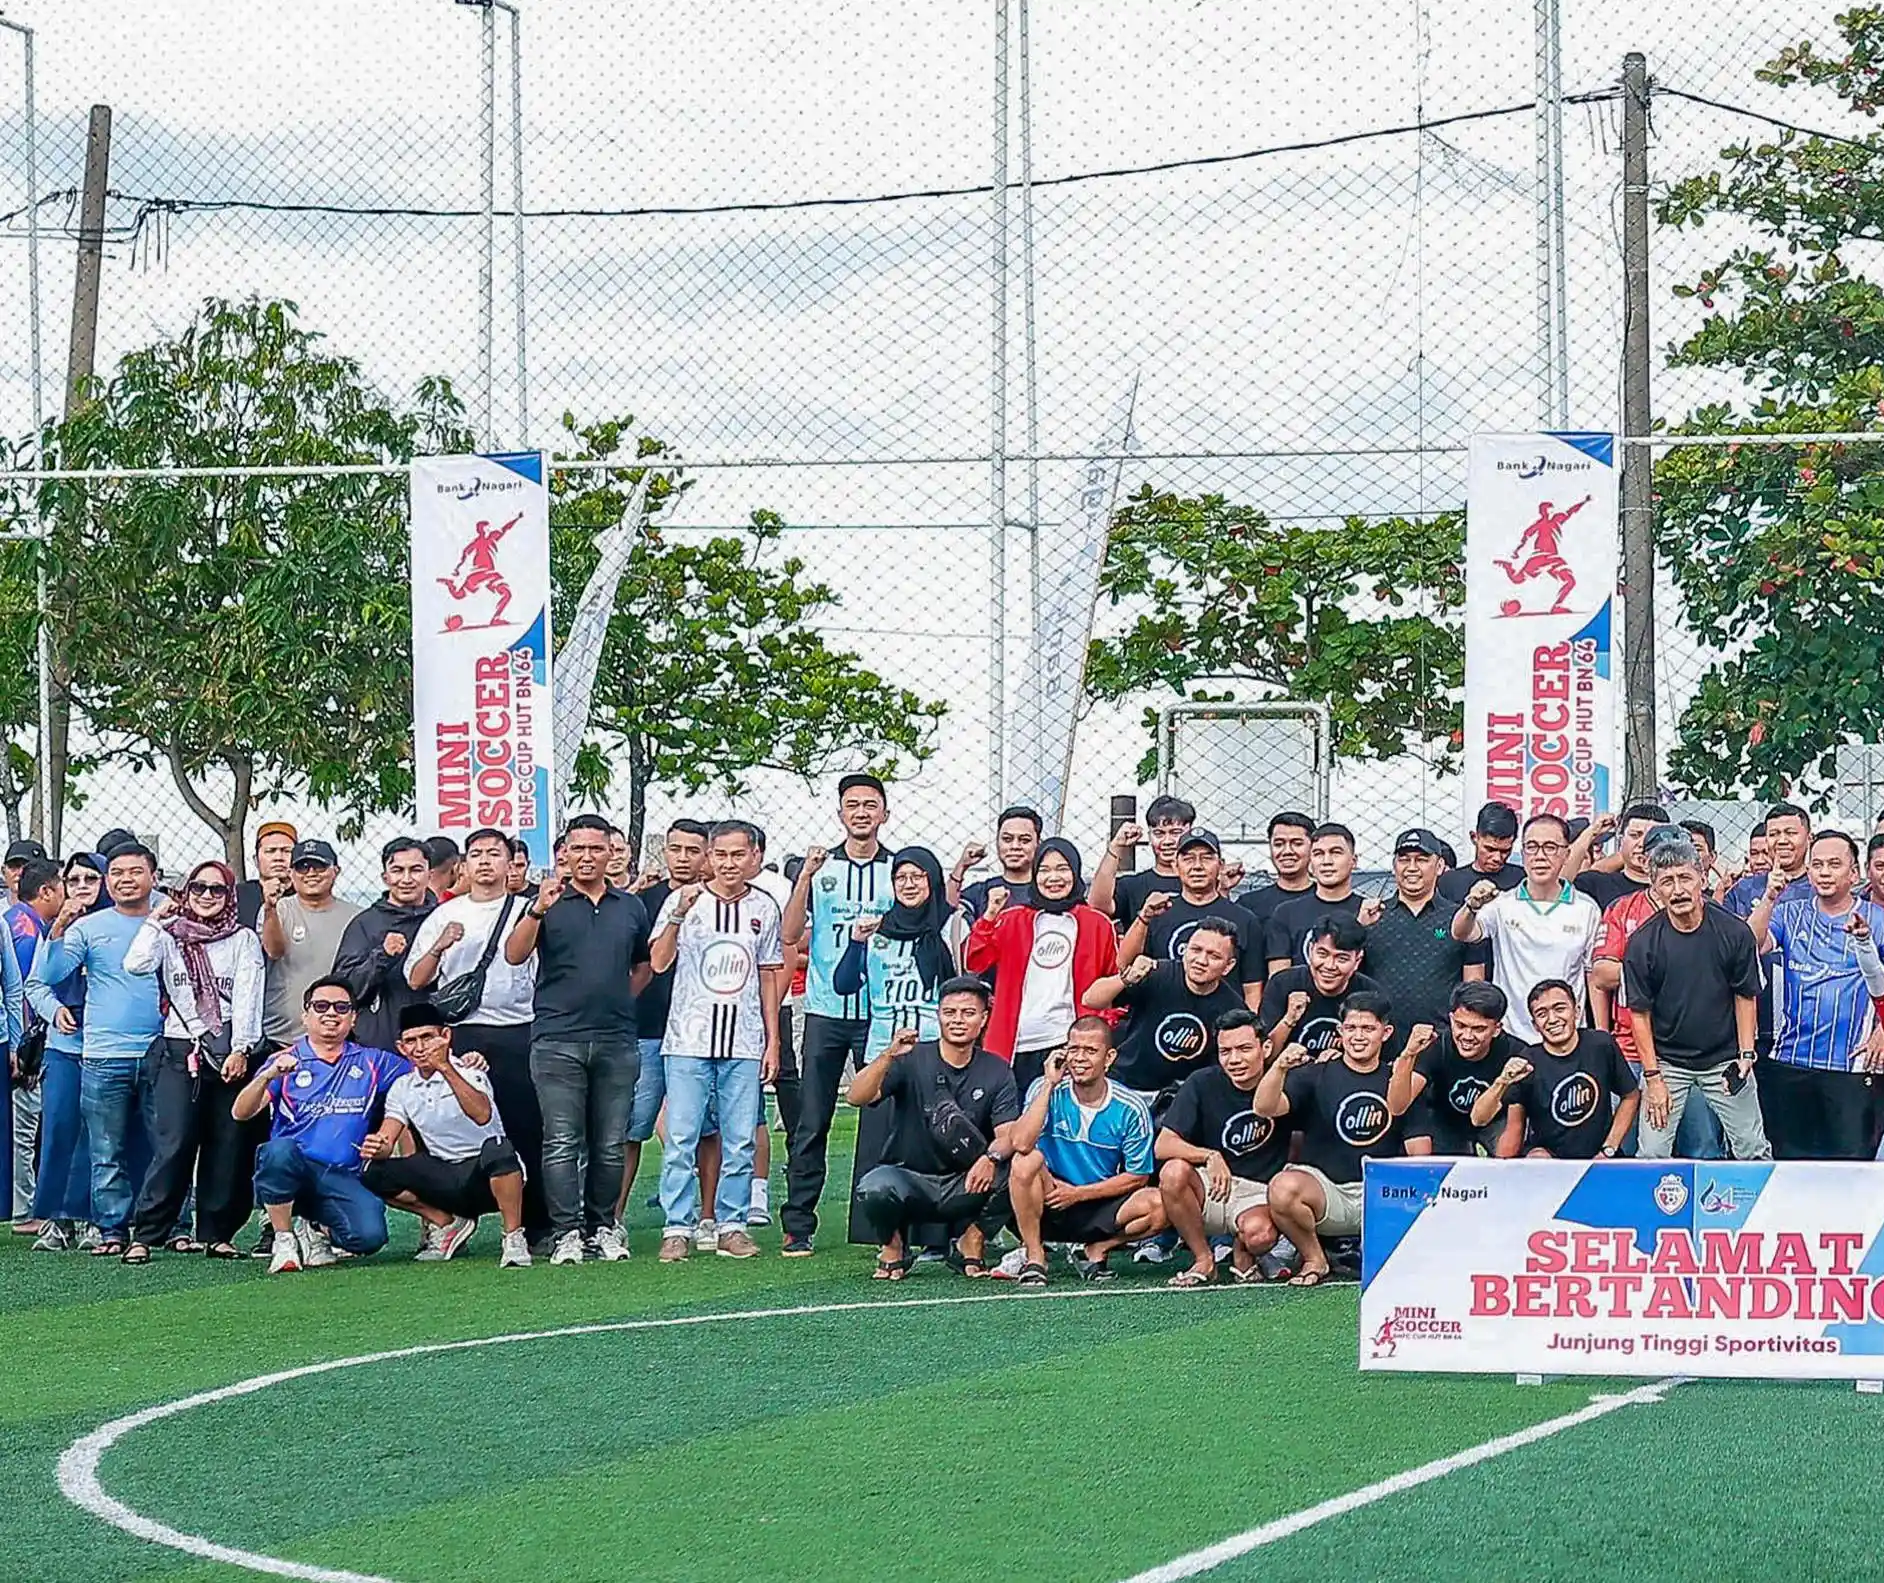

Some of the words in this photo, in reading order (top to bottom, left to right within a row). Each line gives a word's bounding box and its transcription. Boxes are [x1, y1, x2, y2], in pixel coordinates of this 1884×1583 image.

[1496, 461, 1529, 471] Bank
[1546, 460, 1591, 472] Nagari
[437, 484, 465, 493] Bank
[482, 480, 523, 492] Nagari
[514, 650, 531, 671] 64
[1577, 640, 1595, 663] 64
[515, 675, 532, 698] BN
[1576, 668, 1594, 692] BN
[516, 703, 533, 736] HUT
[1575, 697, 1594, 732] HUT
[475, 651, 513, 827] SOCCER
[1530, 641, 1571, 819] SOCCER
[517, 741, 534, 777] CUP
[1575, 738, 1593, 774] CUP
[436, 721, 472, 829] MINI
[1487, 712, 1524, 825] MINI
[518, 781, 535, 828] BNFC
[1575, 780, 1593, 815] NFC
[1036, 941, 1066, 957] ollin
[707, 955, 745, 978] ollin
[1787, 959, 1812, 973] Bank
[1162, 1027, 1200, 1050] ollin
[1307, 1028, 1343, 1050] ollin
[1561, 1085, 1590, 1113] ollin
[1345, 1104, 1383, 1129] ollin
[1230, 1113, 1267, 1146] ollin
[1381, 1185, 1418, 1199] Bank
[1441, 1186, 1489, 1203] Nagari
[1525, 1230, 1863, 1275] SELAMAT
[1394, 1306, 1437, 1319] MINI
[1394, 1320, 1462, 1333] SOCCER
[1546, 1332, 1635, 1355] Junjung
[1640, 1332, 1709, 1354] Tinggi
[1715, 1335, 1838, 1356] Sportivitas
